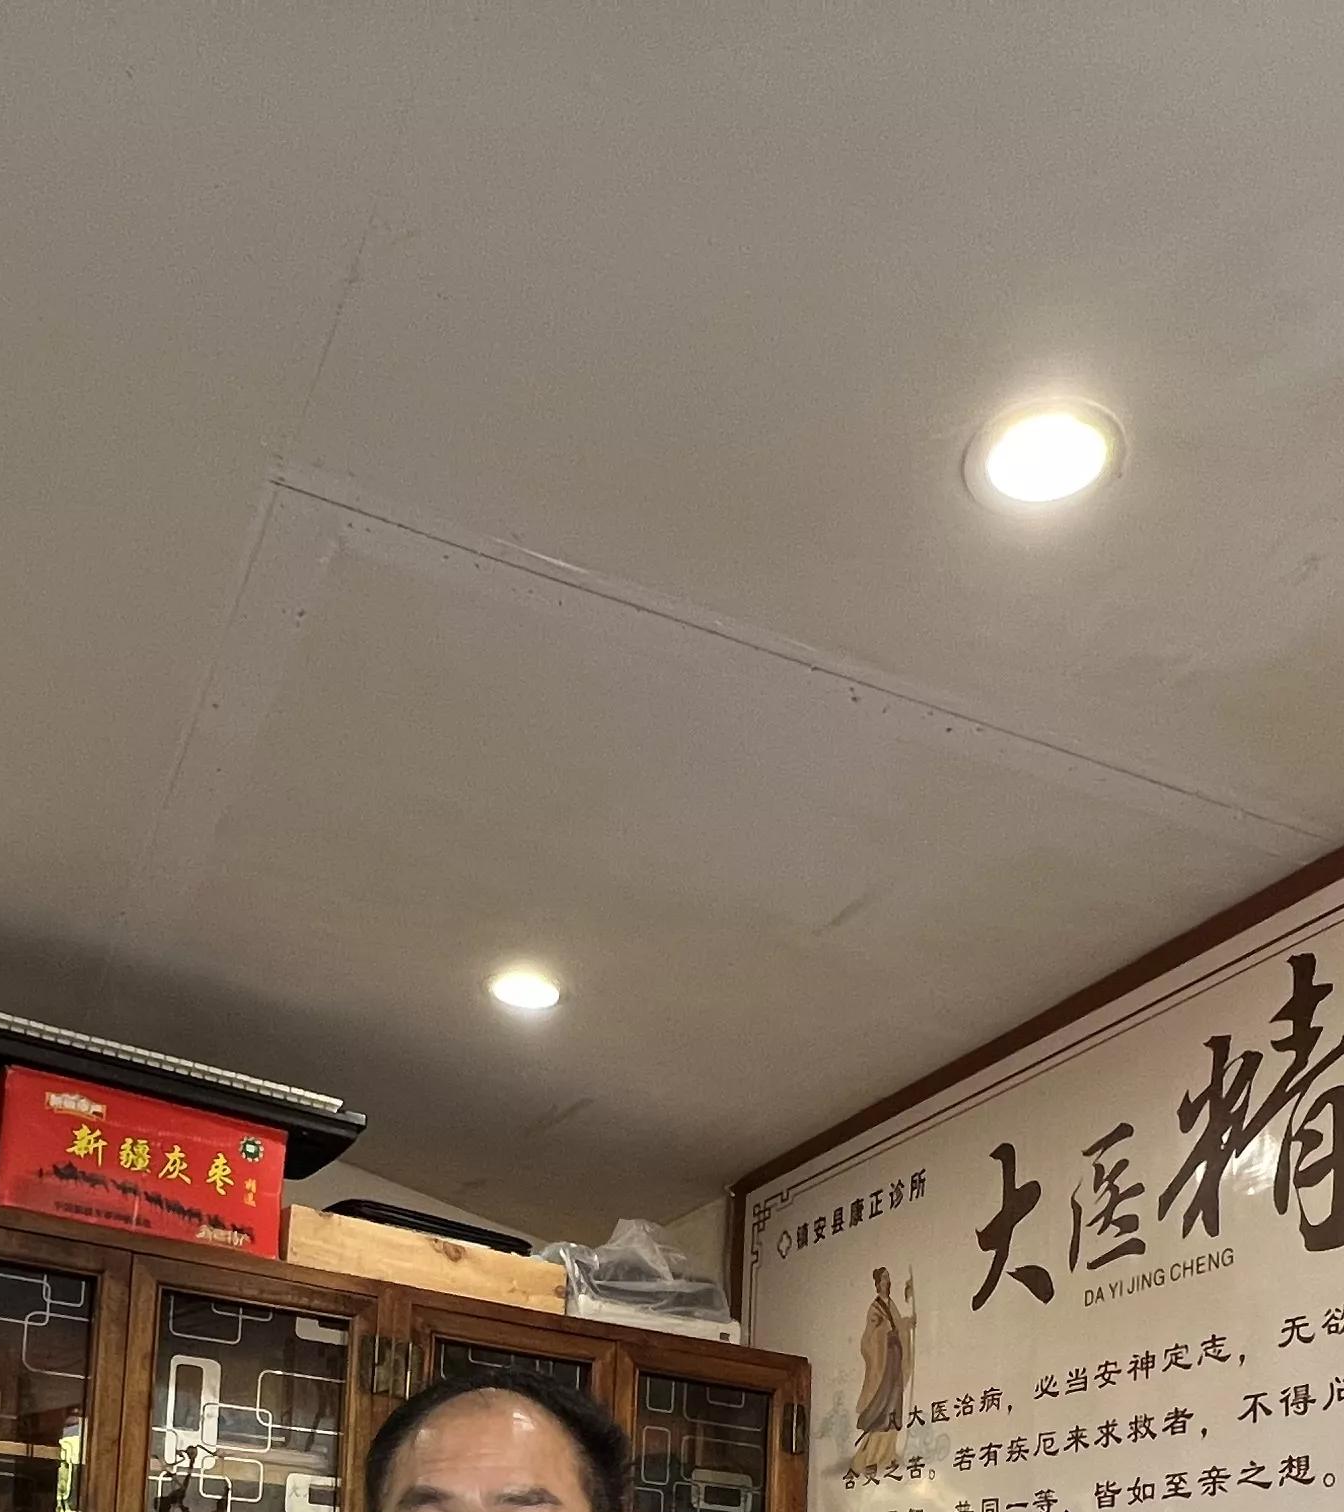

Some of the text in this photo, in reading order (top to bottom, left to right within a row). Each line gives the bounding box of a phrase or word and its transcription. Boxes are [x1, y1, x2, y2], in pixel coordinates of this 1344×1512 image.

[66, 1123, 235, 1196] 新疆灰枣
[1084, 1247, 1234, 1307] DA YI JING CHENG
